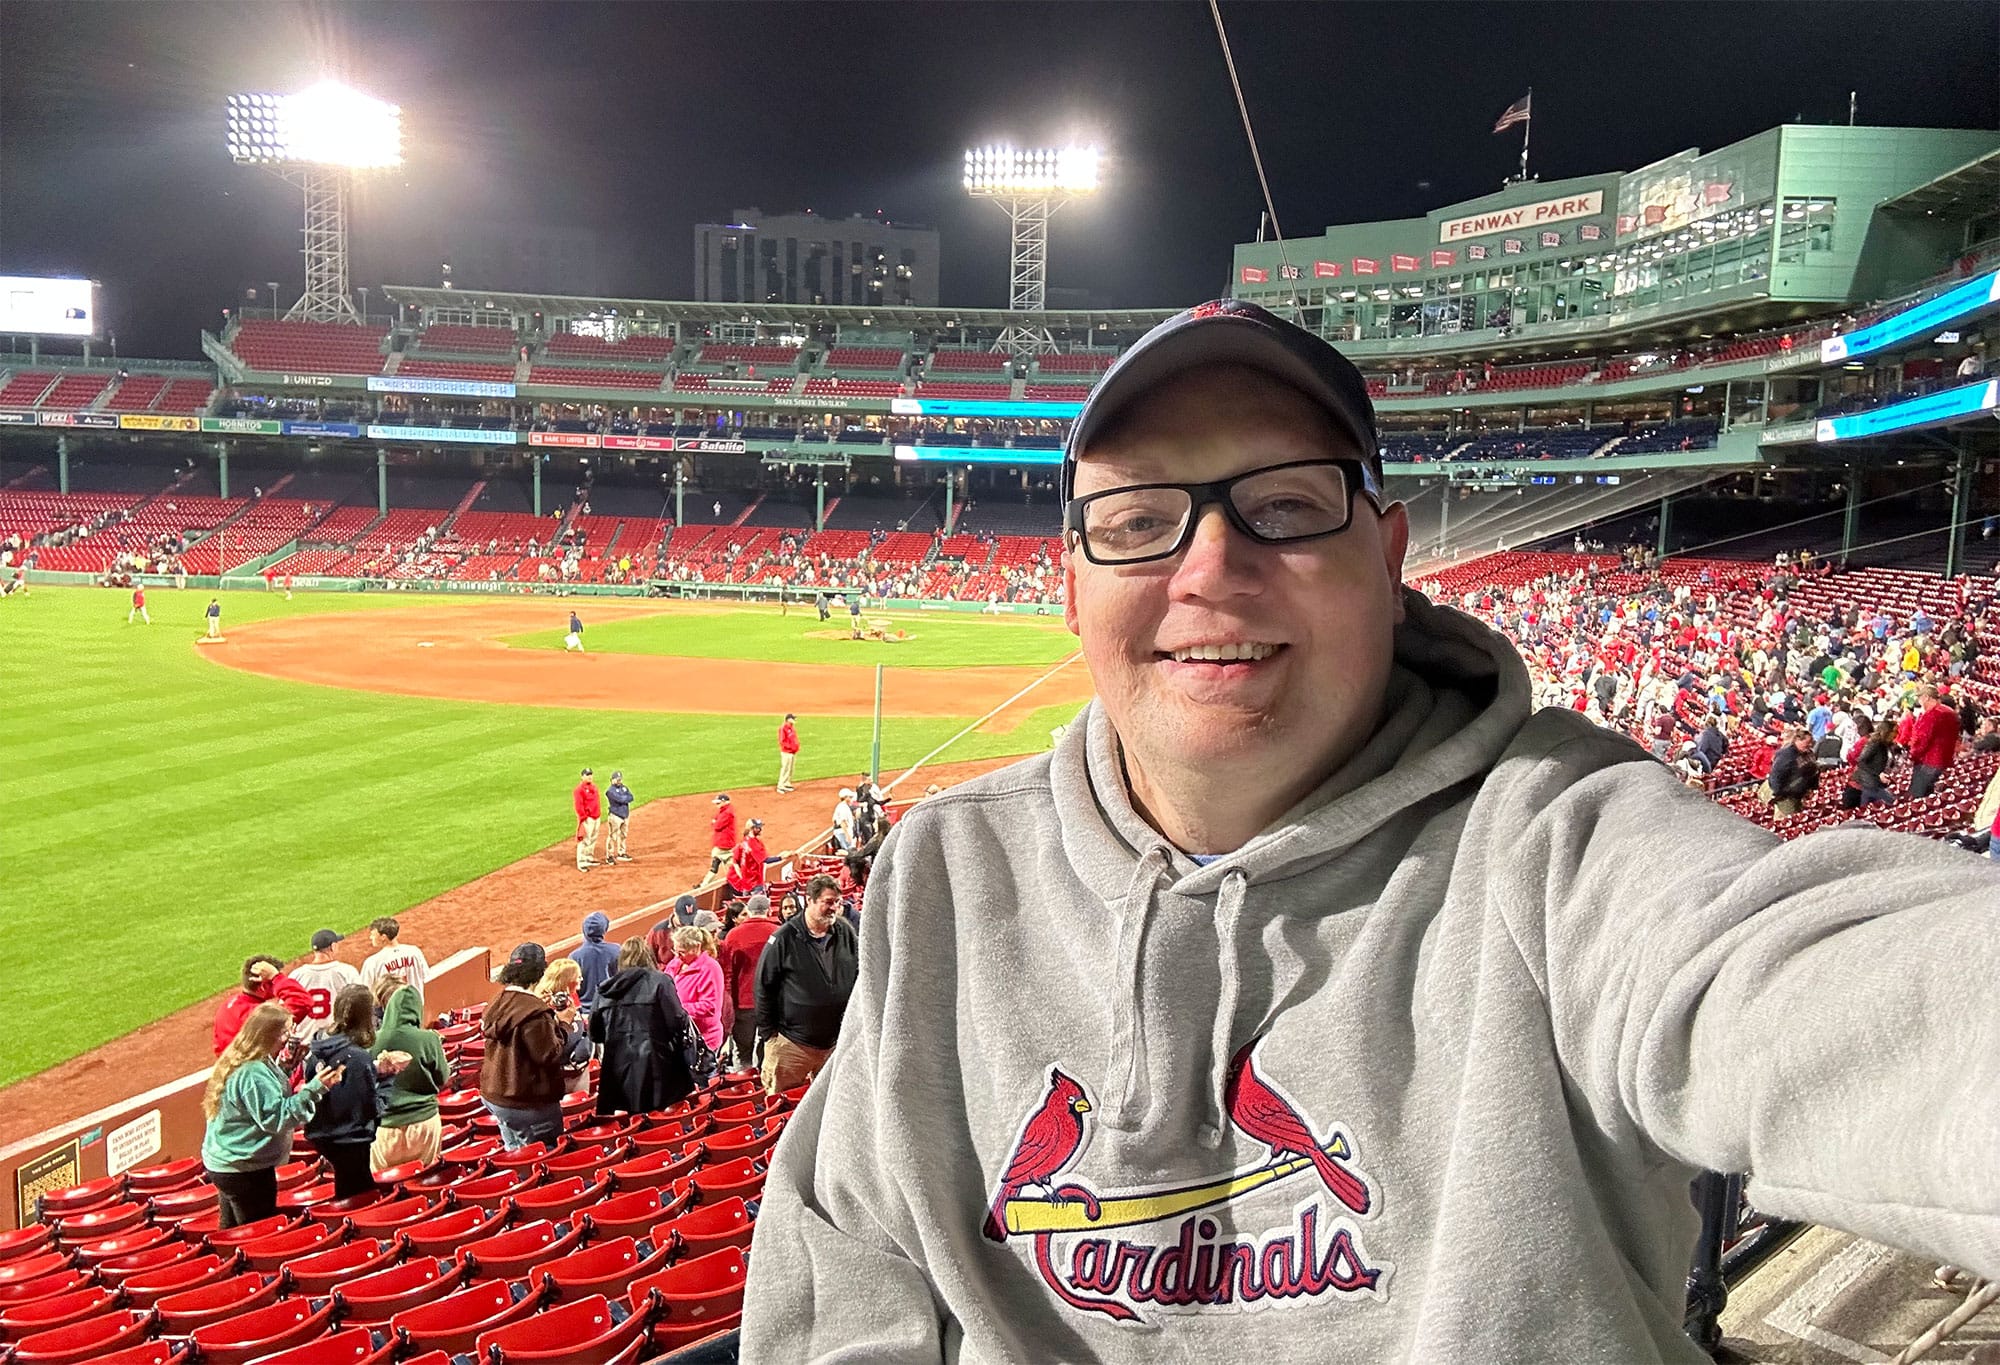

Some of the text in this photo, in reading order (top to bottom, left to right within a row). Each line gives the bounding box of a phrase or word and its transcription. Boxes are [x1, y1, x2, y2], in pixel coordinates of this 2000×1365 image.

[1449, 198, 1590, 238] FENWAY PARK
[293, 376, 333, 385] UNITED
[793, 398, 816, 406] STREET
[817, 399, 848, 407] PAVILION
[700, 441, 744, 451] Safelite
[385, 956, 415, 973] MOLINA
[1033, 1184, 1382, 1324] Cardinals
